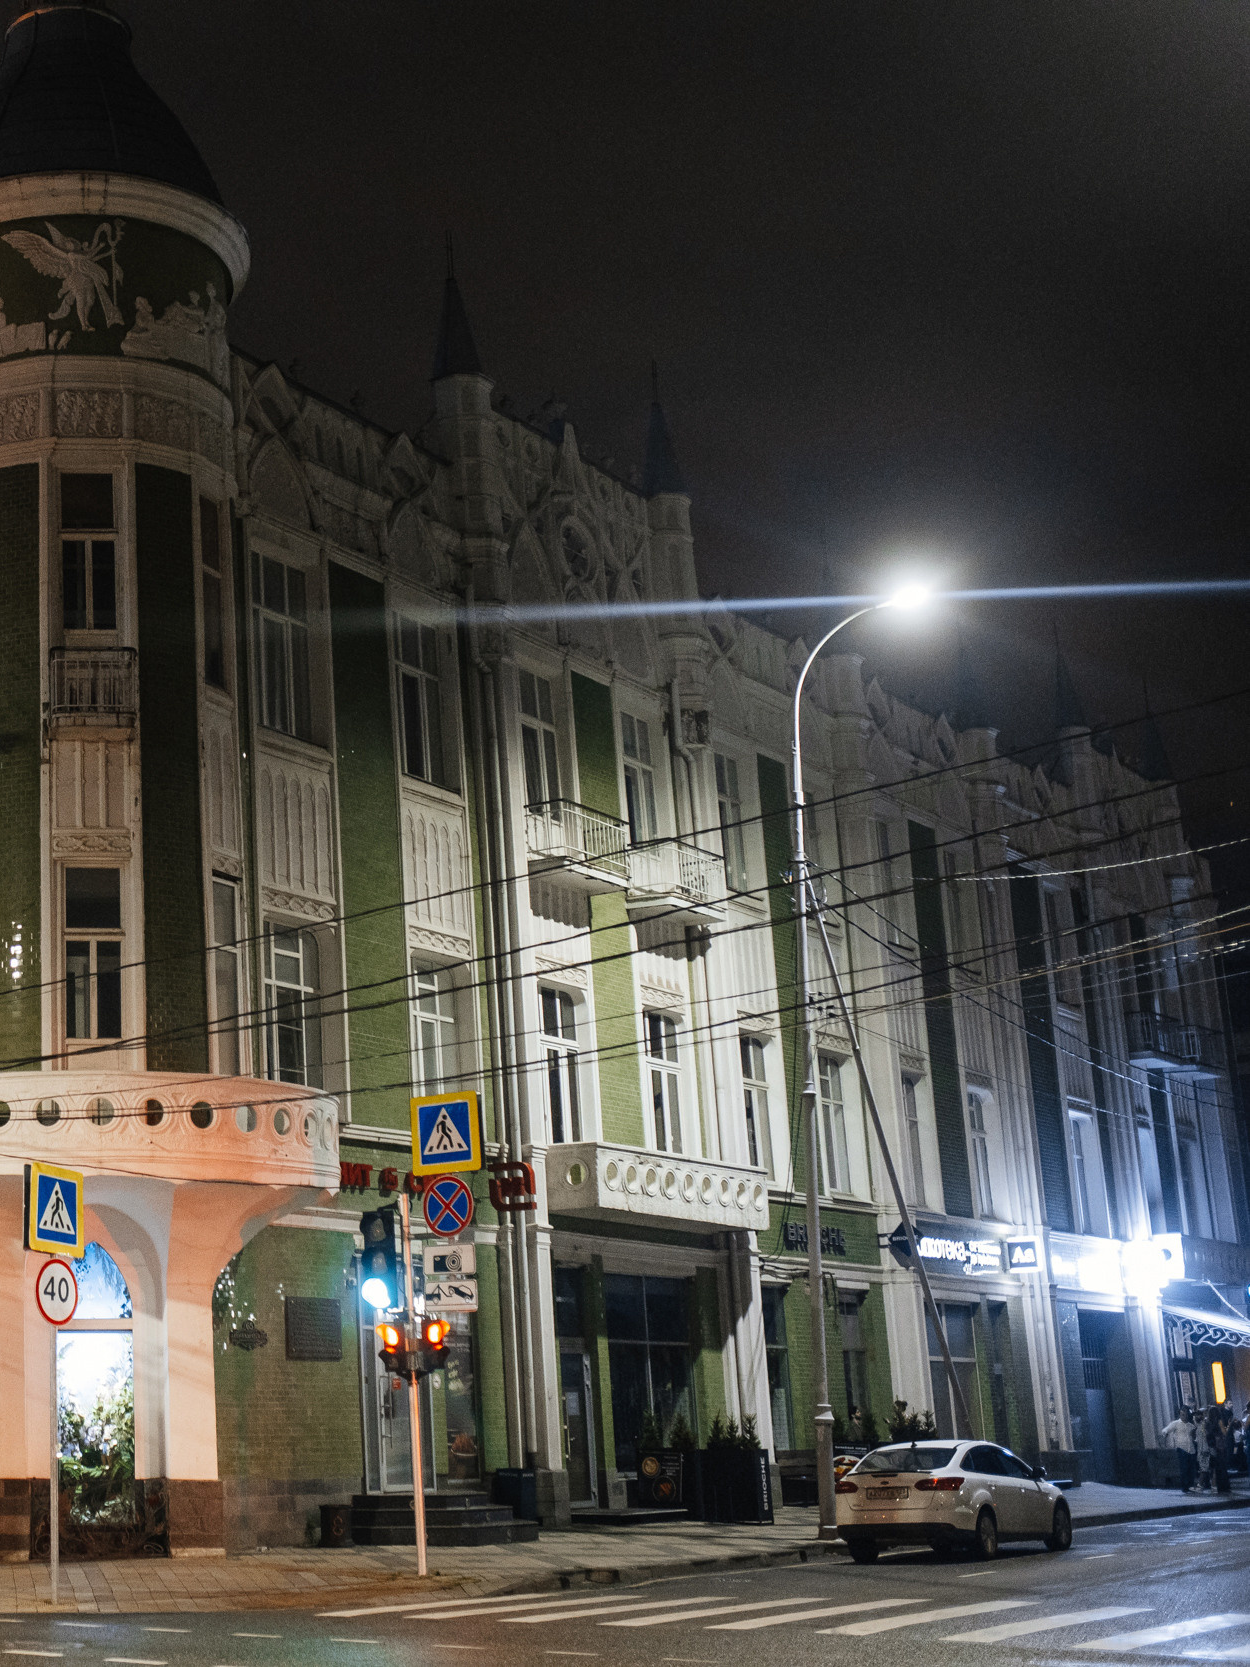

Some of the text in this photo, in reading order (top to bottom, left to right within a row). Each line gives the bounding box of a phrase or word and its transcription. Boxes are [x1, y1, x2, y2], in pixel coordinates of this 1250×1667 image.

[785, 1221, 846, 1246] BRCHE
[43, 1276, 69, 1303] 40
[760, 1456, 769, 1511] BRIOCHE
